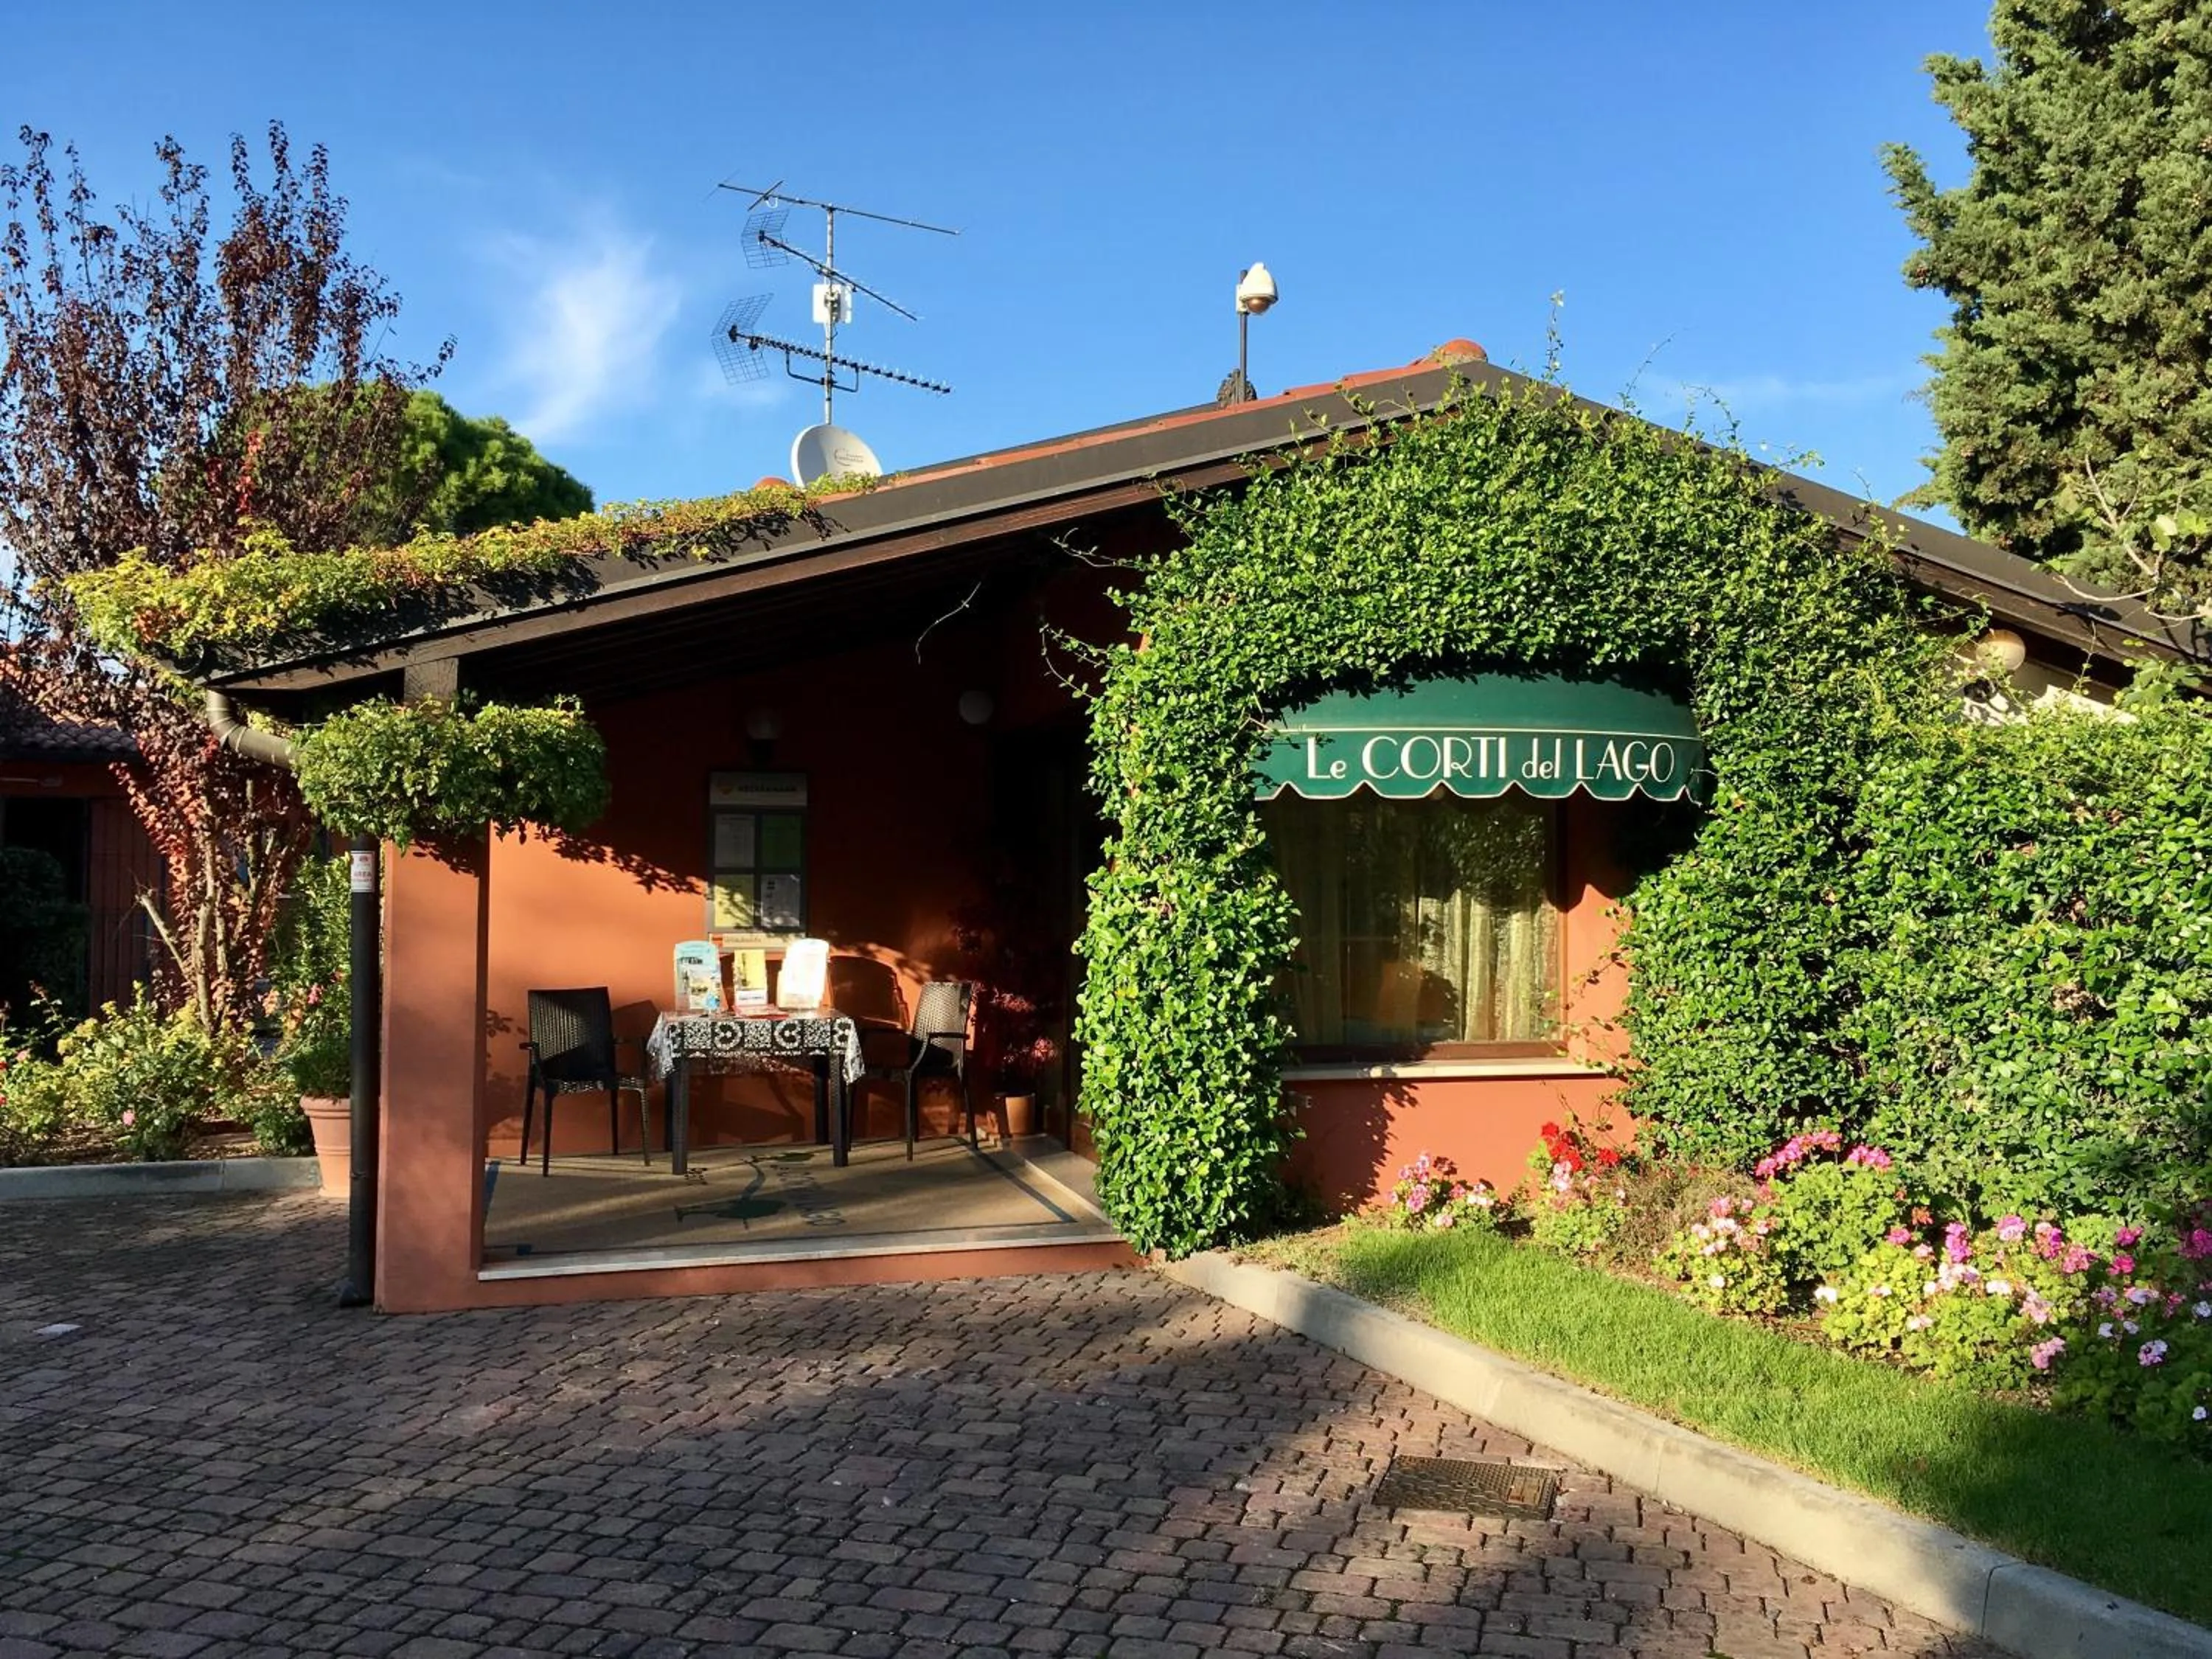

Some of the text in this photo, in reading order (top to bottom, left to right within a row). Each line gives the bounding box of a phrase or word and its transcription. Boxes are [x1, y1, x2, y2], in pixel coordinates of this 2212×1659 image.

[1307, 735, 1674, 783] Le CORTI del LAGO
